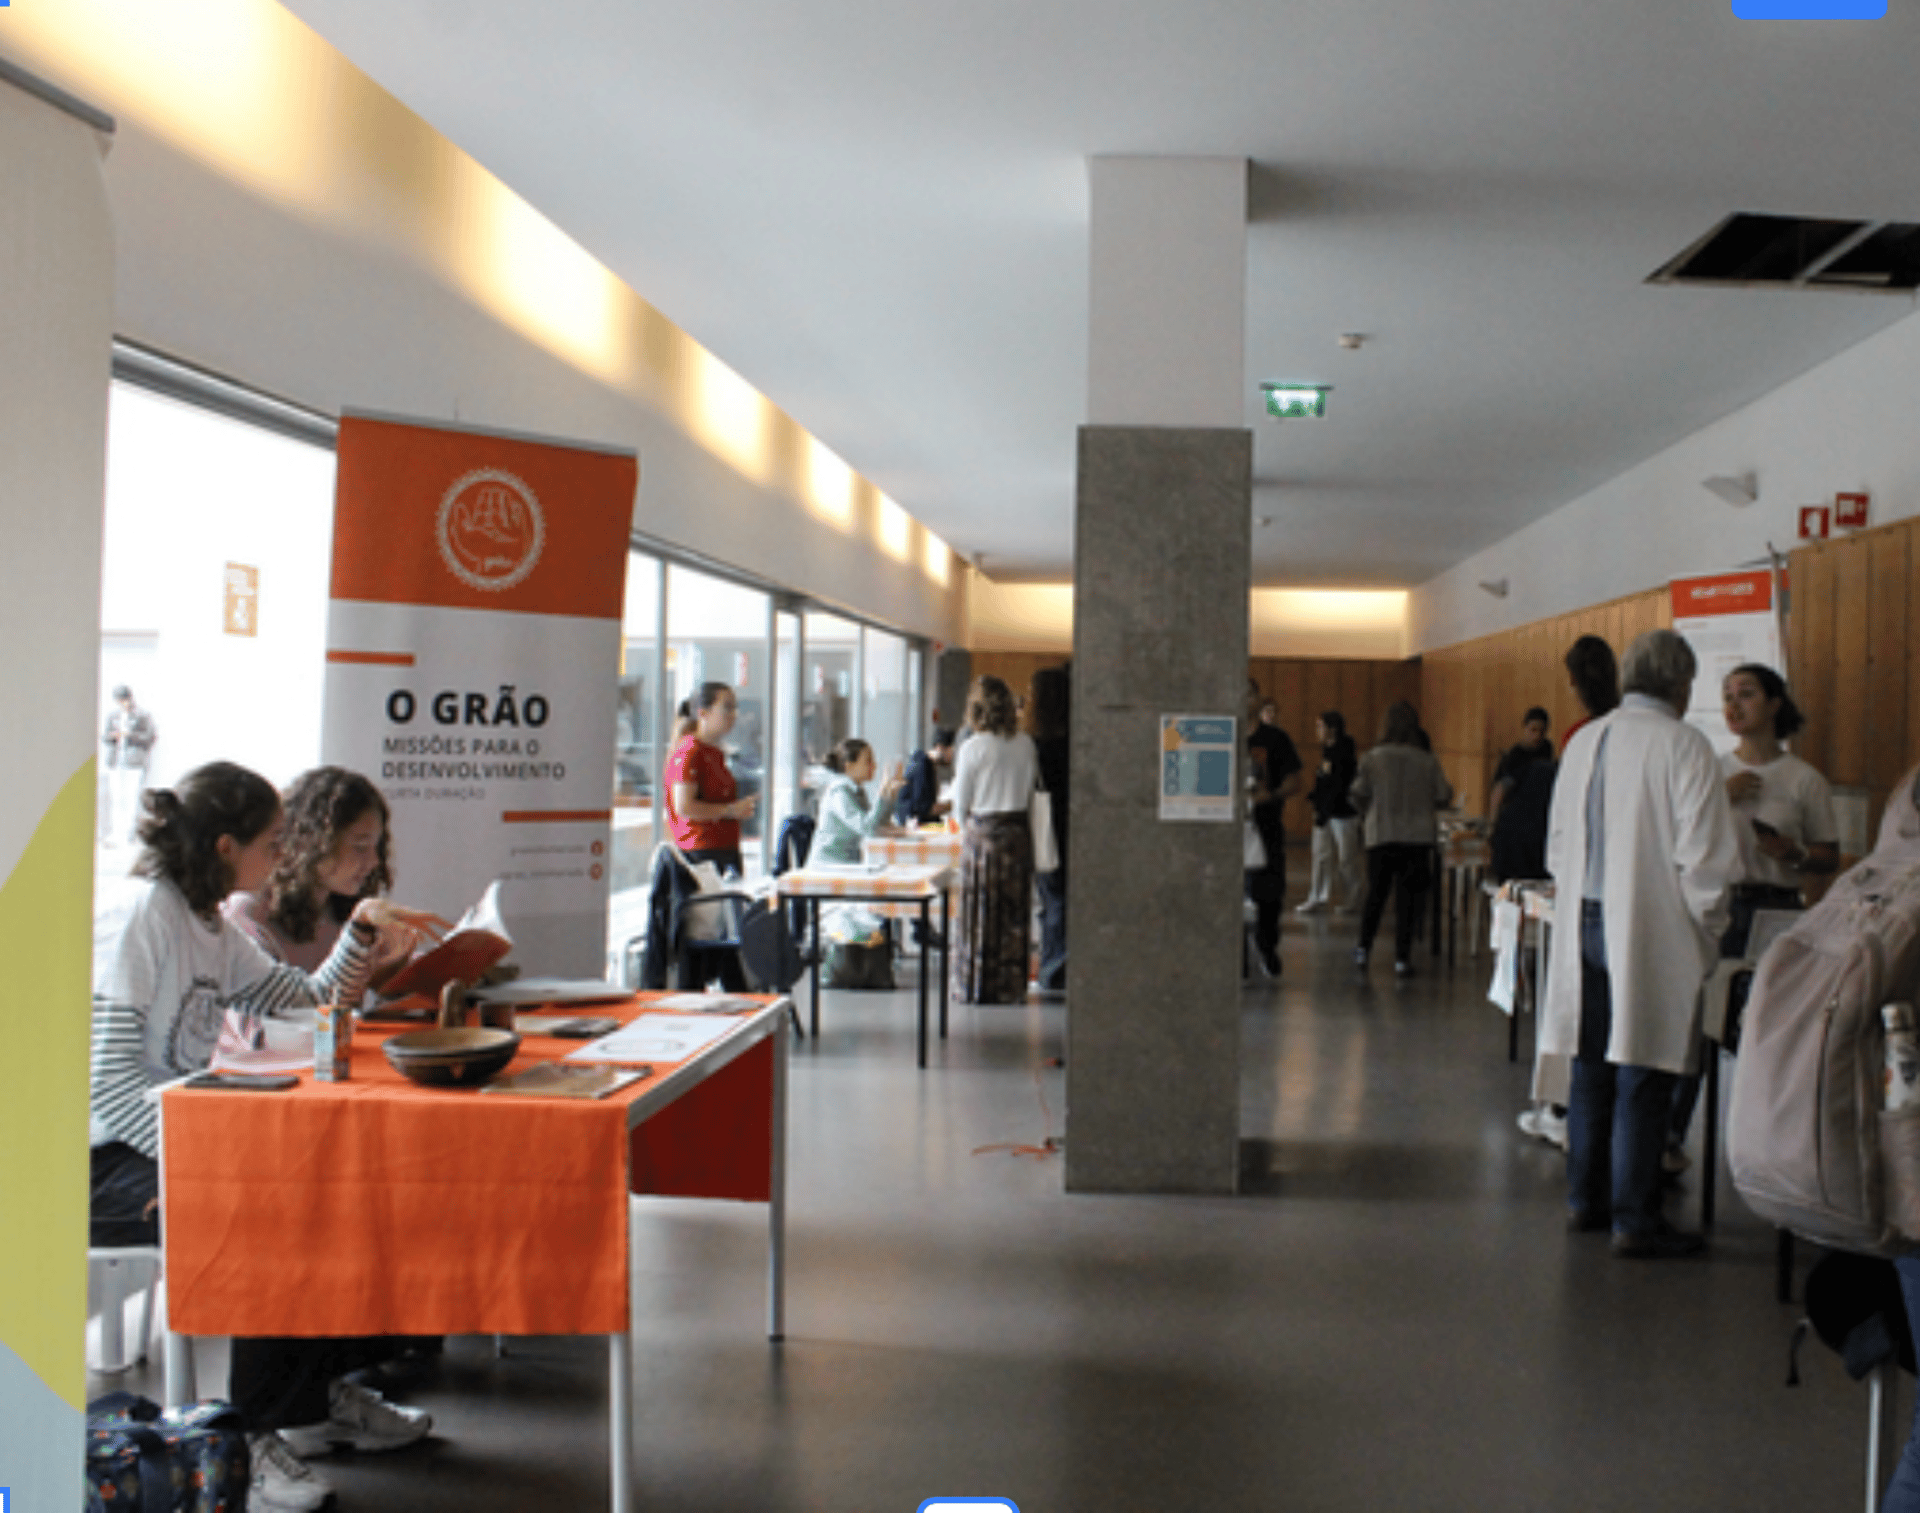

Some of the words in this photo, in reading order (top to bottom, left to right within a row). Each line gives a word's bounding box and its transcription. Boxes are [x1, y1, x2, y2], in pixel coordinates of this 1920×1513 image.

[386, 689, 416, 725] O
[432, 684, 549, 729] GRÃO
[385, 735, 466, 755] MISSÕES
[472, 738, 521, 756] PARA
[526, 739, 540, 757] O
[382, 761, 566, 780] DESENVOLVIMENTO
